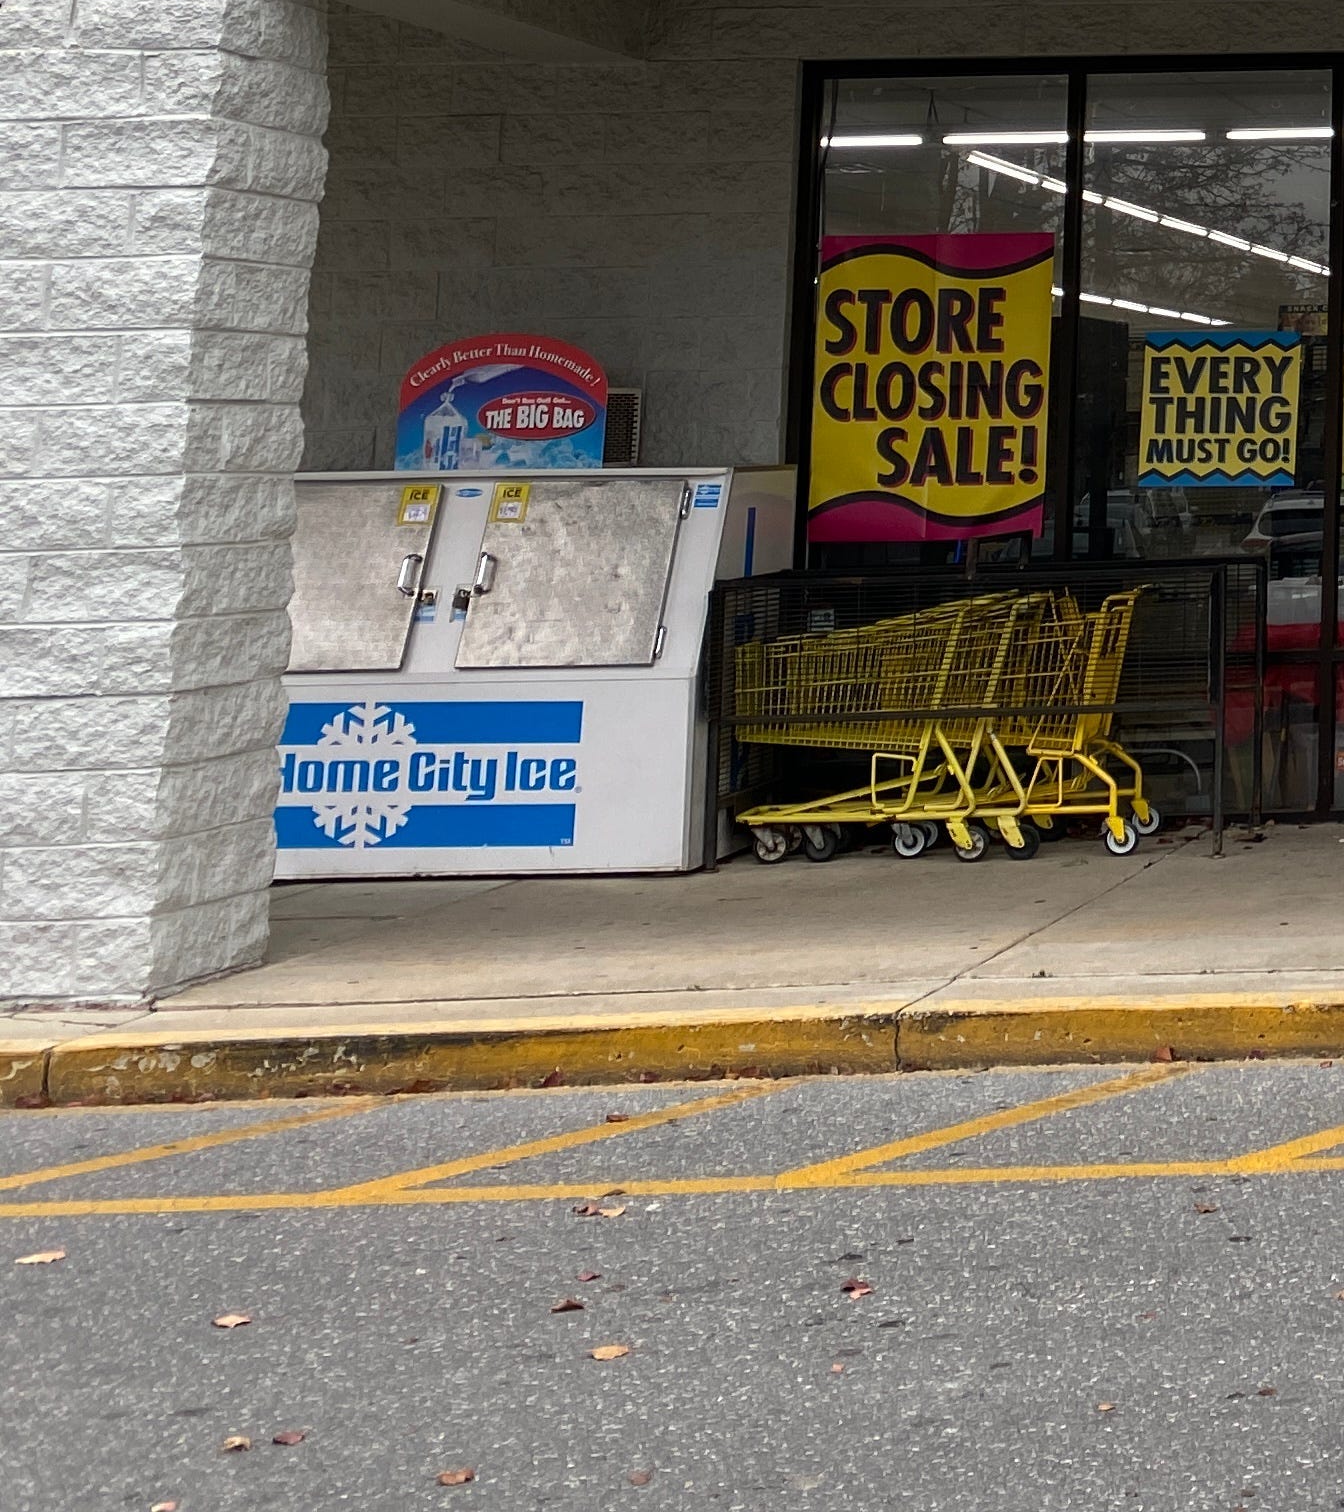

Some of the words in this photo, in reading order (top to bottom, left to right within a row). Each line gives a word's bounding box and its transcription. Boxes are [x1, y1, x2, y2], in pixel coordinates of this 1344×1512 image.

[824, 287, 1006, 356] STORE
[409, 356, 451, 387] Clearly
[453, 347, 493, 364] Better
[494, 343, 527, 357] Than
[1150, 356, 1294, 394] EVERY
[820, 359, 1044, 422] CLOSING
[486, 410, 512, 429] THE
[516, 405, 549, 429] BIG
[552, 407, 585, 429] BAG
[1149, 396, 1292, 434] THING
[876, 425, 1038, 488] SALE!
[1146, 439, 1231, 464] MUST
[1236, 438, 1291, 464] GO!
[409, 489, 430, 501] ICE
[502, 488, 523, 498] ICE
[407, 751, 498, 800] City
[504, 751, 577, 791] Ice
